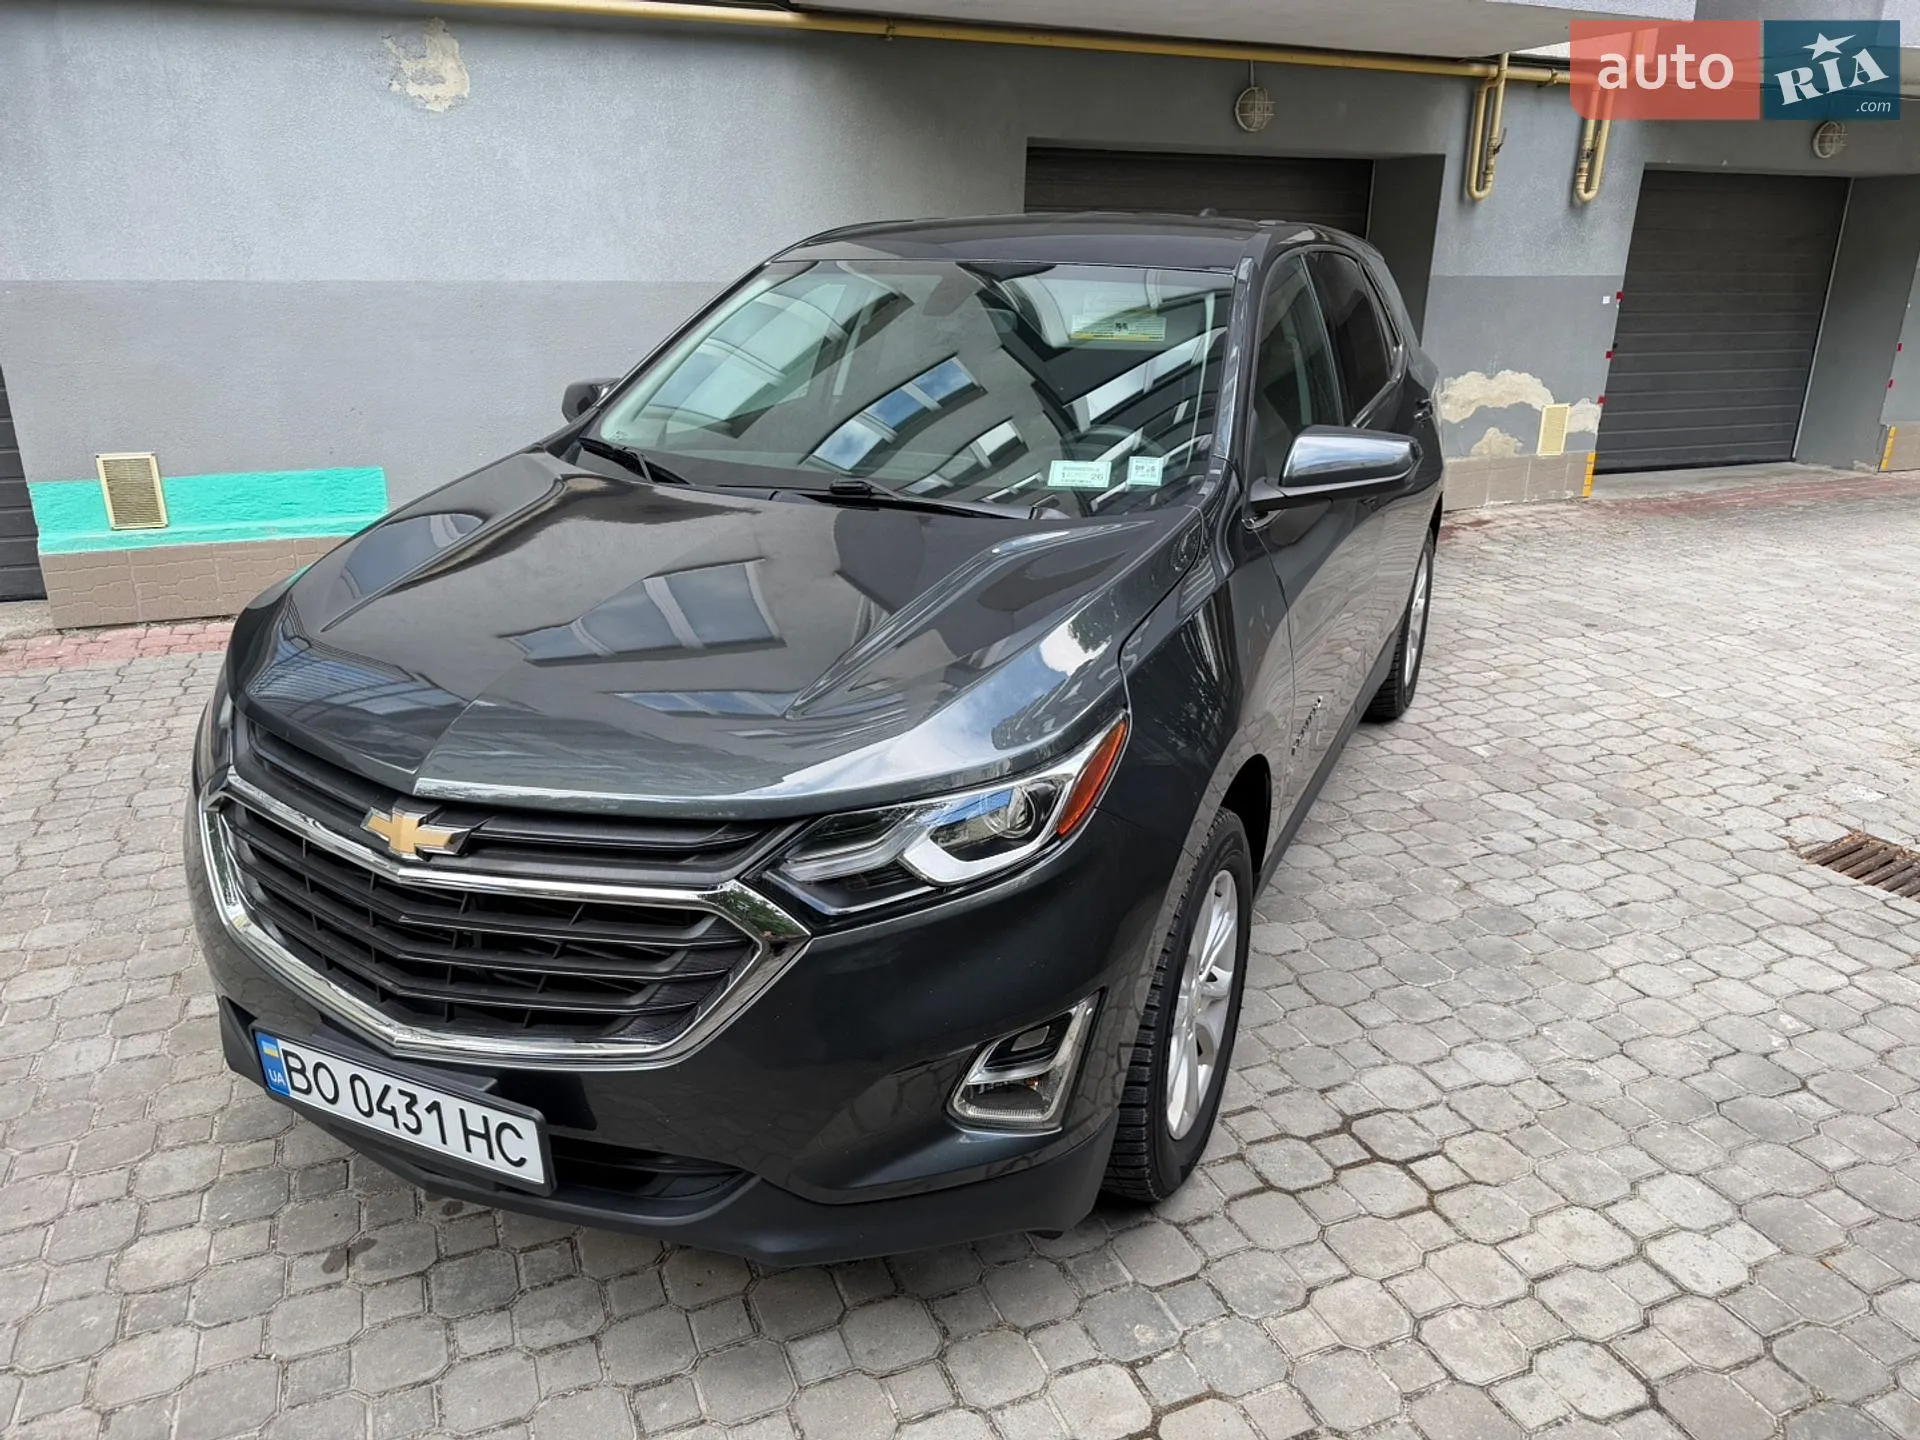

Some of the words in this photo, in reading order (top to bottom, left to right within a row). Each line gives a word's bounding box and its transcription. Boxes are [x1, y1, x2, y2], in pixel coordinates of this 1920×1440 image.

[267, 1068, 287, 1085] UA
[282, 1049, 340, 1105] BO
[350, 1073, 448, 1145] 0431
[459, 1108, 528, 1168] HC
